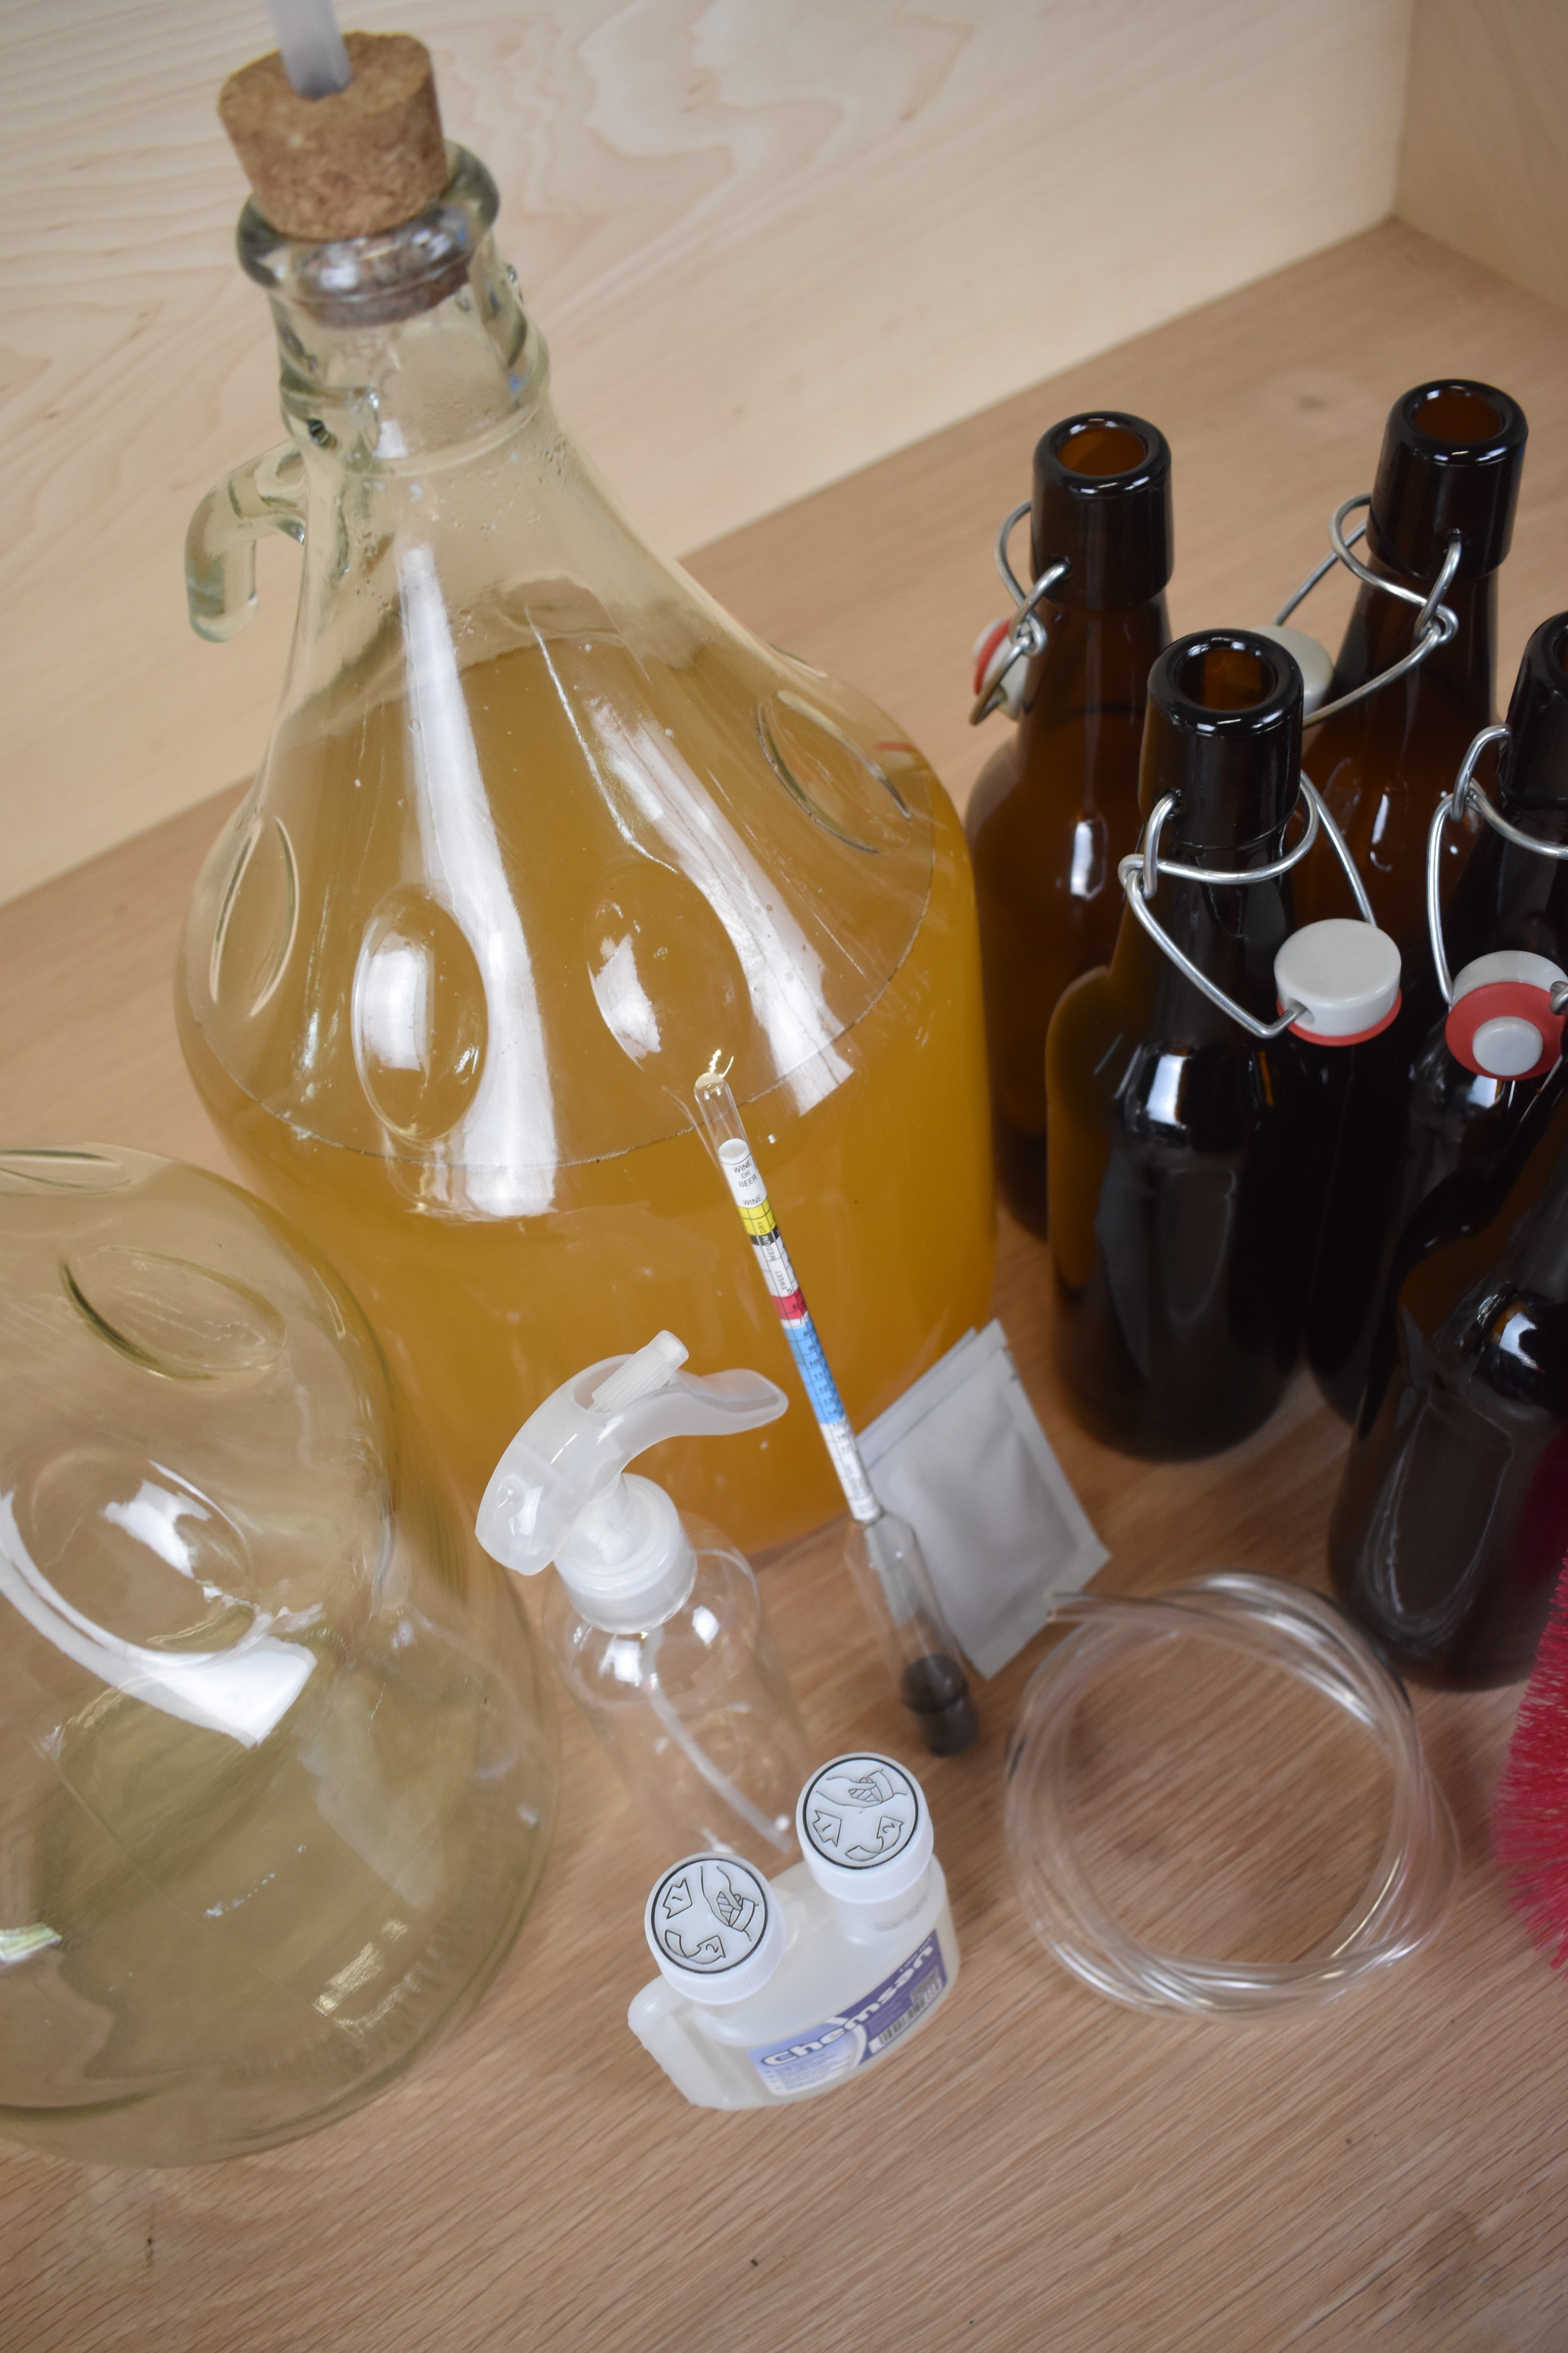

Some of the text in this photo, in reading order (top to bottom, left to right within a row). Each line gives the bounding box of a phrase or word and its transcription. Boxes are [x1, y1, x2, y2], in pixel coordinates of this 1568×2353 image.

[733, 1159, 752, 1173] WINE
[739, 1174, 757, 1187] BEER
[741, 1170, 750, 1179] OR
[743, 1194, 762, 1205] WINE
[757, 1221, 766, 1233] DRY
[762, 1235, 776, 1261] MEDIUM
[775, 1271, 787, 1290] SWEET
[882, 1822, 894, 1834] 2
[705, 1943, 719, 1953] 2
[762, 1946, 933, 2065] Chemsan
